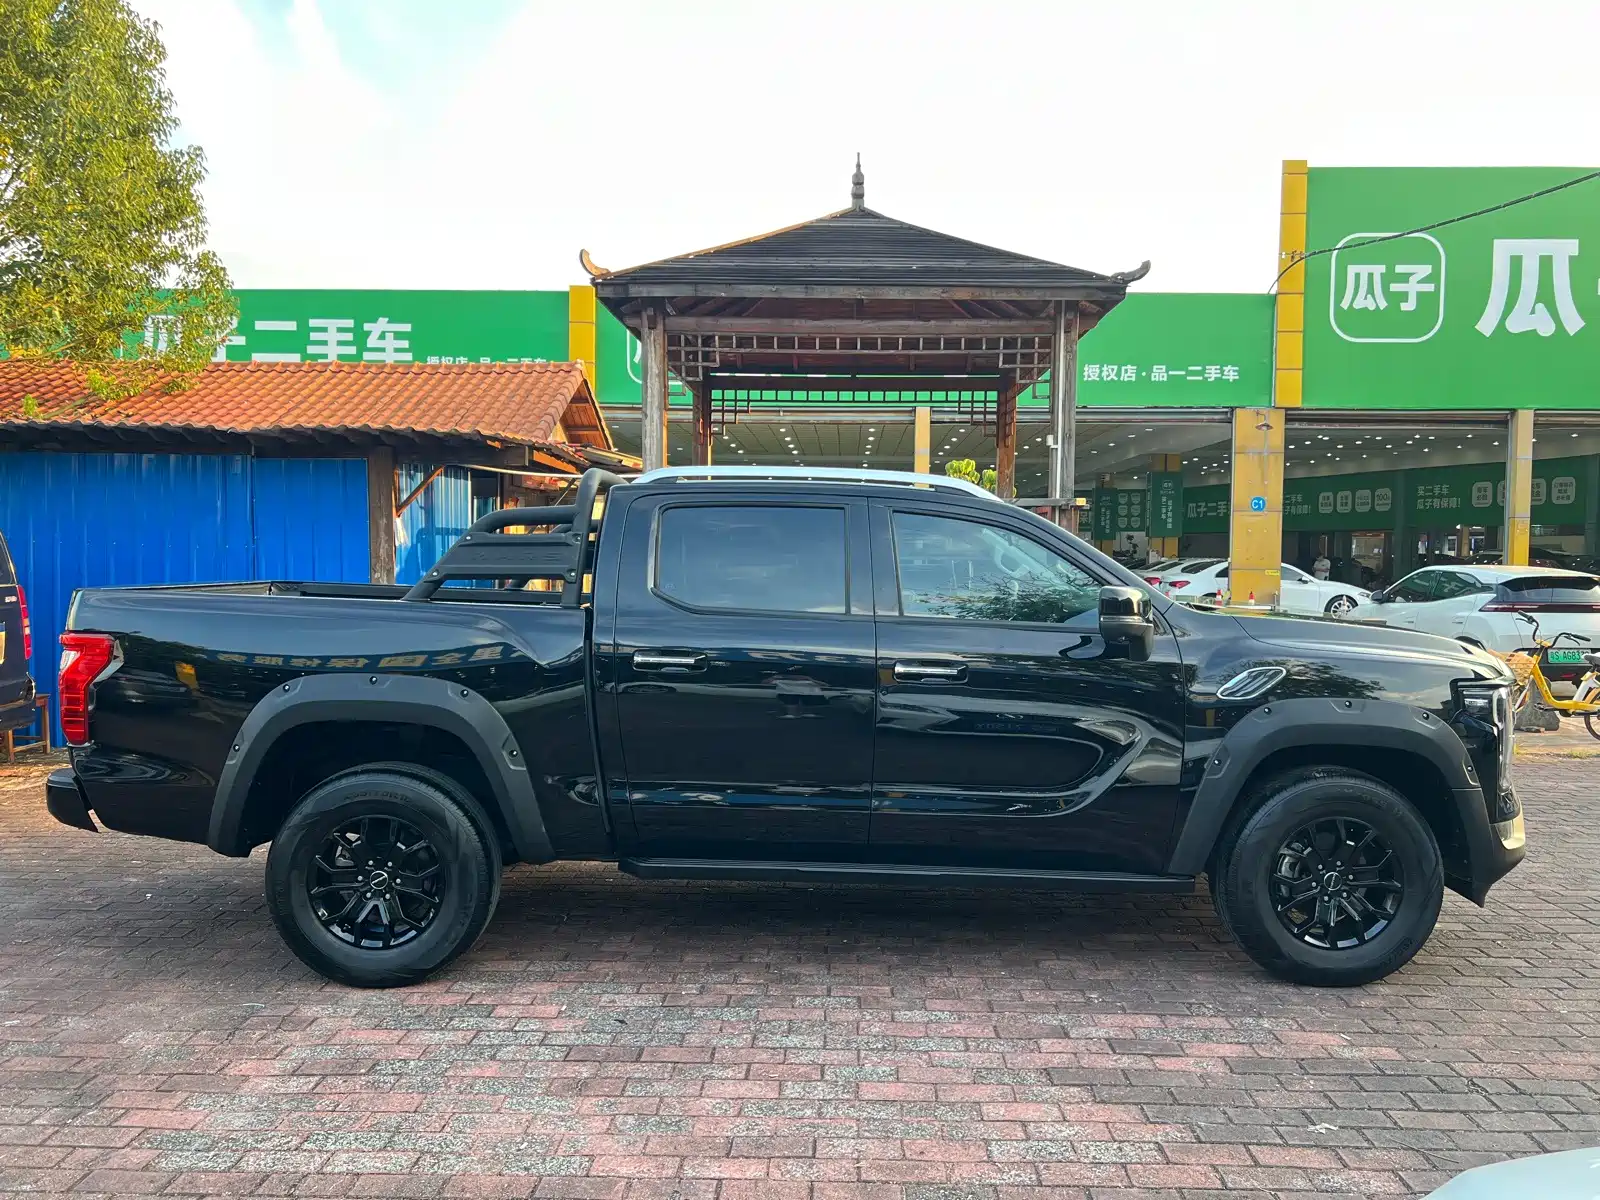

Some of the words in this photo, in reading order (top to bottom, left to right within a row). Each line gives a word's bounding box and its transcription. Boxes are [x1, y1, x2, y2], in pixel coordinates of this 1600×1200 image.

[1340, 265, 1434, 310] 瓜子
[1475, 239, 1600, 337] 瓜
[1187, 501, 1230, 518] 瓜子二手
[1252, 499, 1263, 509] C1
